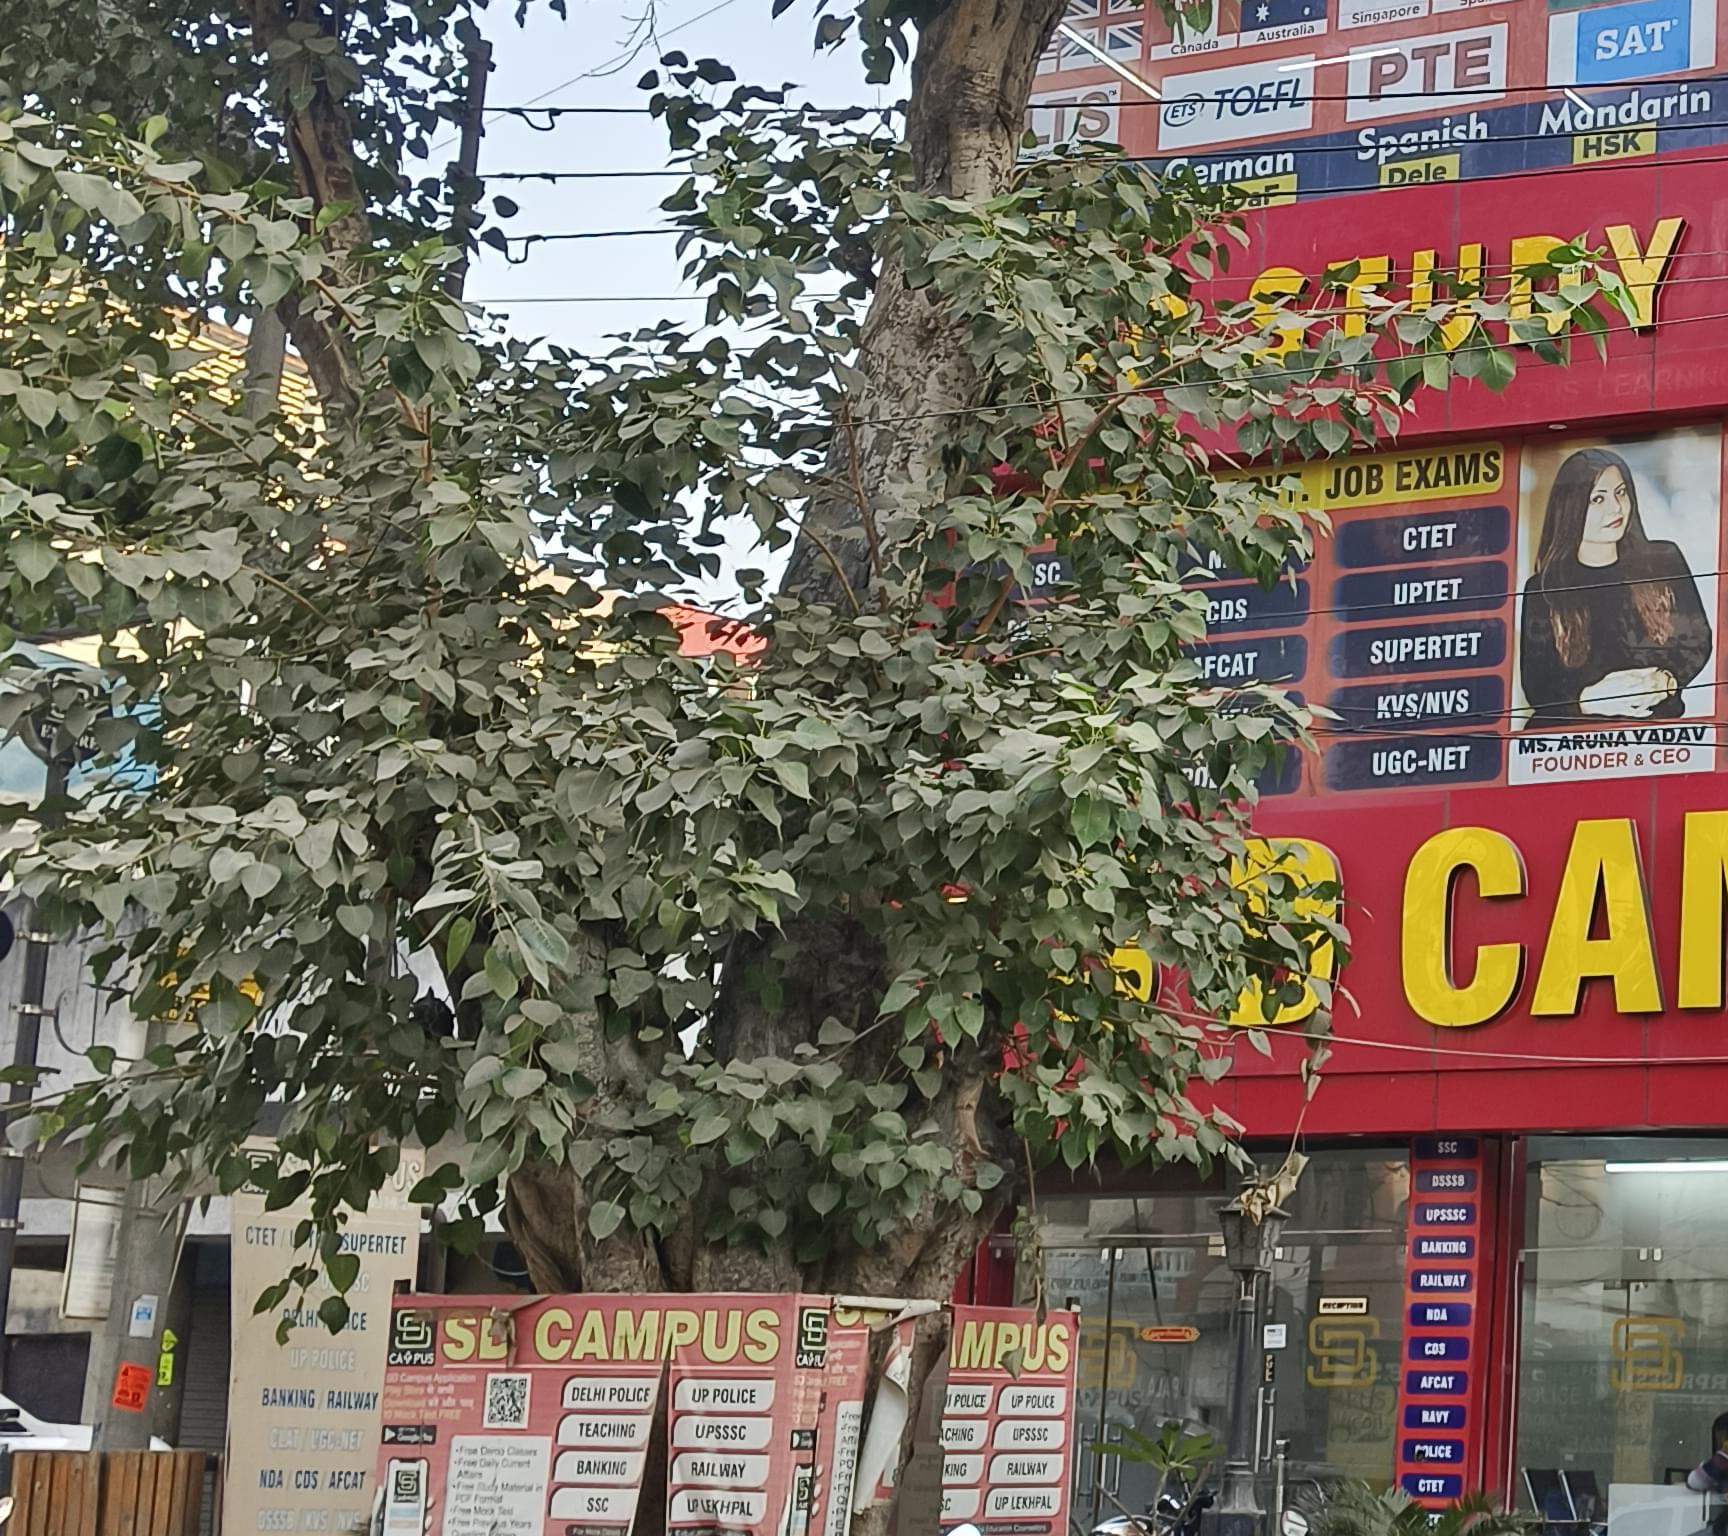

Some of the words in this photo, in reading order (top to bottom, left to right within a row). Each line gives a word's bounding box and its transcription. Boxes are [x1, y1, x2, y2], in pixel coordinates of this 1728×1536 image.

[1351, 4, 1421, 27] Singapore
[1256, 23, 1315, 44] Australia
[1595, 20, 1672, 62] SAT
[1170, 37, 1220, 56] Canada
[1368, 34, 1492, 105] PTE
[1214, 77, 1306, 122] TOEFL
[1538, 85, 1711, 136] Mandarin
[1357, 113, 1489, 165] Spanish
[1582, 132, 1641, 159] HSK
[1388, 161, 1447, 186] Dele
[1325, 465, 1384, 501] JOB
[1395, 450, 1501, 492] EXAMS
[1402, 523, 1458, 552] CTET
[1393, 577, 1463, 607] UPTET
[1369, 632, 1482, 666] SUPERTET
[1371, 746, 1471, 778] UGC-NET
[1531, 751, 1629, 776] FOUNDER
[1647, 748, 1693, 767] CEO
[534, 1307, 781, 1363] CAMPUS
[262, 1387, 316, 1409] BANKING
[327, 1390, 379, 1411] RAILWAY
[571, 1385, 602, 1403] DELHI
[608, 1386, 651, 1405] POLICE
[691, 1387, 710, 1404] UP
[713, 1387, 757, 1405] POLICE
[578, 1422, 636, 1440] TEACHING
[695, 1424, 747, 1441] UPSSSC
[259, 1469, 283, 1489] NDA
[295, 1470, 318, 1490] CDS
[328, 1470, 367, 1491] AFCAT
[576, 1459, 627, 1476] BANKING
[690, 1460, 746, 1479] RAILWAY
[1007, 1462, 1048, 1477] RAILWAY
[586, 1496, 609, 1513] SSC
